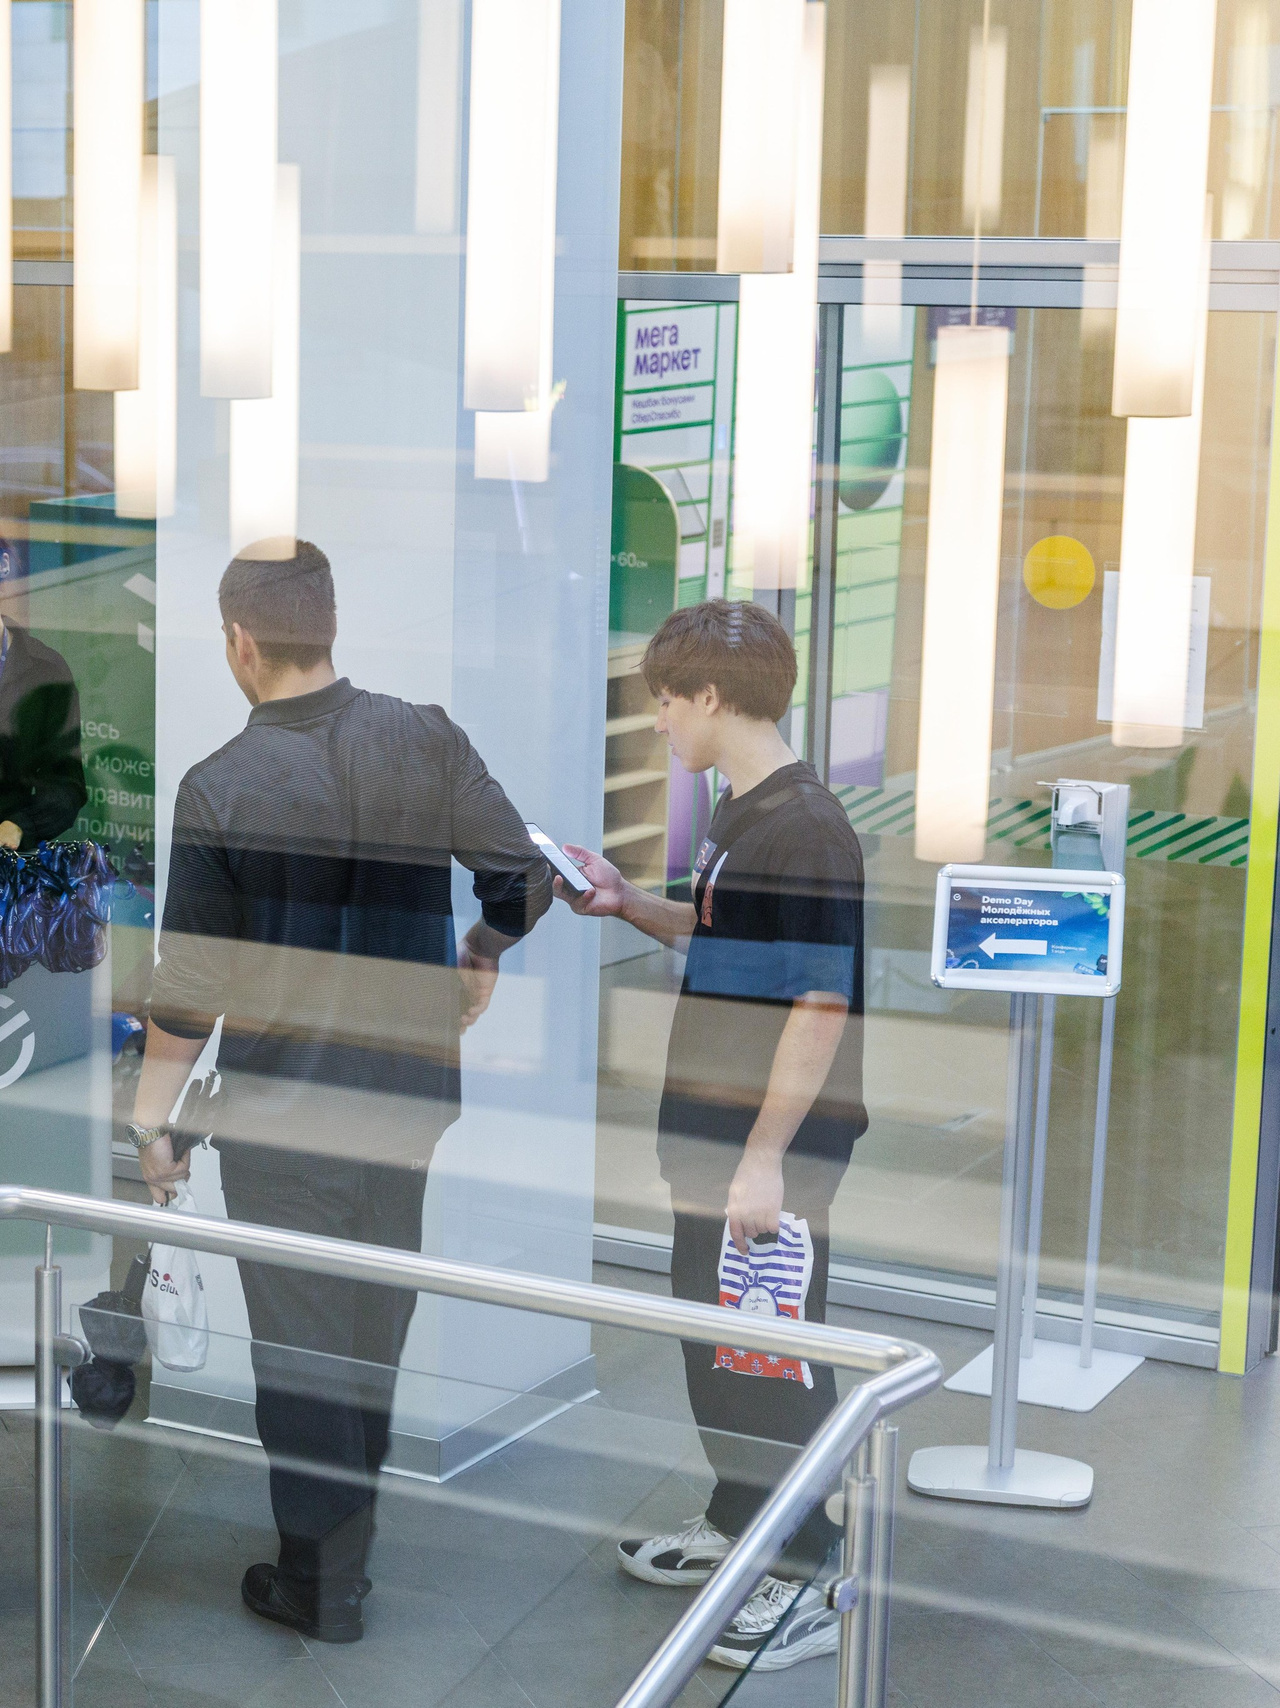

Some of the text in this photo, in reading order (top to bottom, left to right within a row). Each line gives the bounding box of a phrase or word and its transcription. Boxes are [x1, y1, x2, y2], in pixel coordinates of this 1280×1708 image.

[981, 895, 1034, 908] Demo Day
[981, 905, 1051, 917] Молодёжных
[980, 917, 1059, 927] акселераторов
